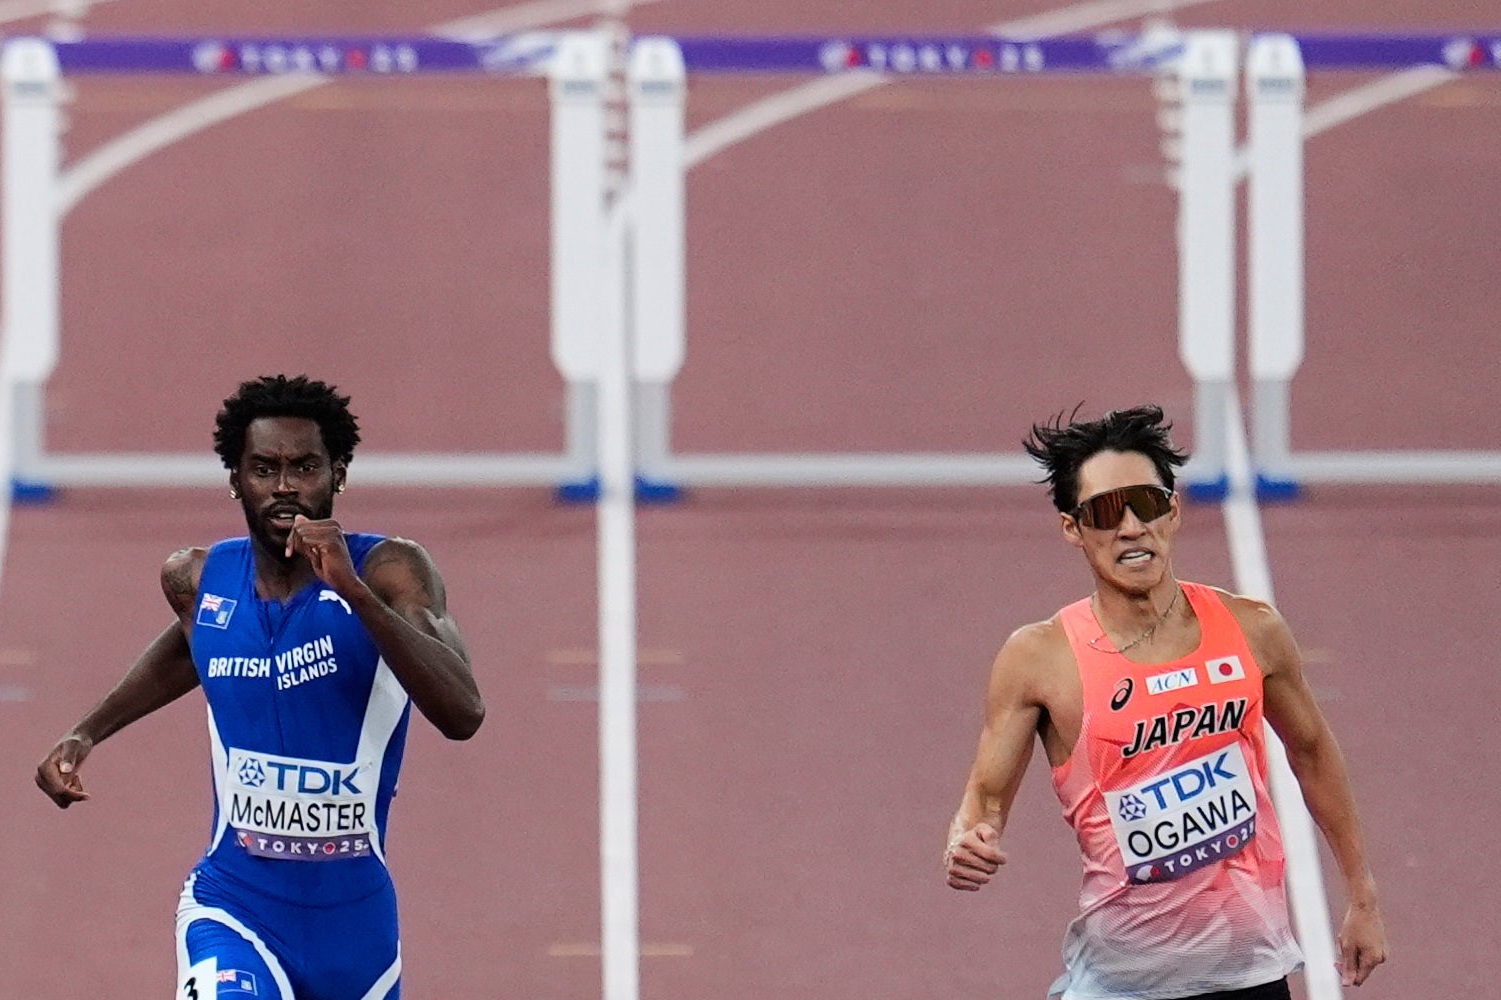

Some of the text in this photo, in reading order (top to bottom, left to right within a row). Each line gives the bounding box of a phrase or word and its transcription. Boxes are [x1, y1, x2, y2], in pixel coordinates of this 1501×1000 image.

[208, 635, 334, 678] BRITISH VIRGIN
[277, 658, 337, 690] ISLANDS
[1152, 671, 1193, 693] ACN
[1122, 699, 1249, 758] JAPAN
[267, 761, 363, 796] TDK
[1140, 752, 1237, 811] TDK
[231, 793, 366, 832] McMASTER
[1128, 789, 1252, 858] OGAWA
